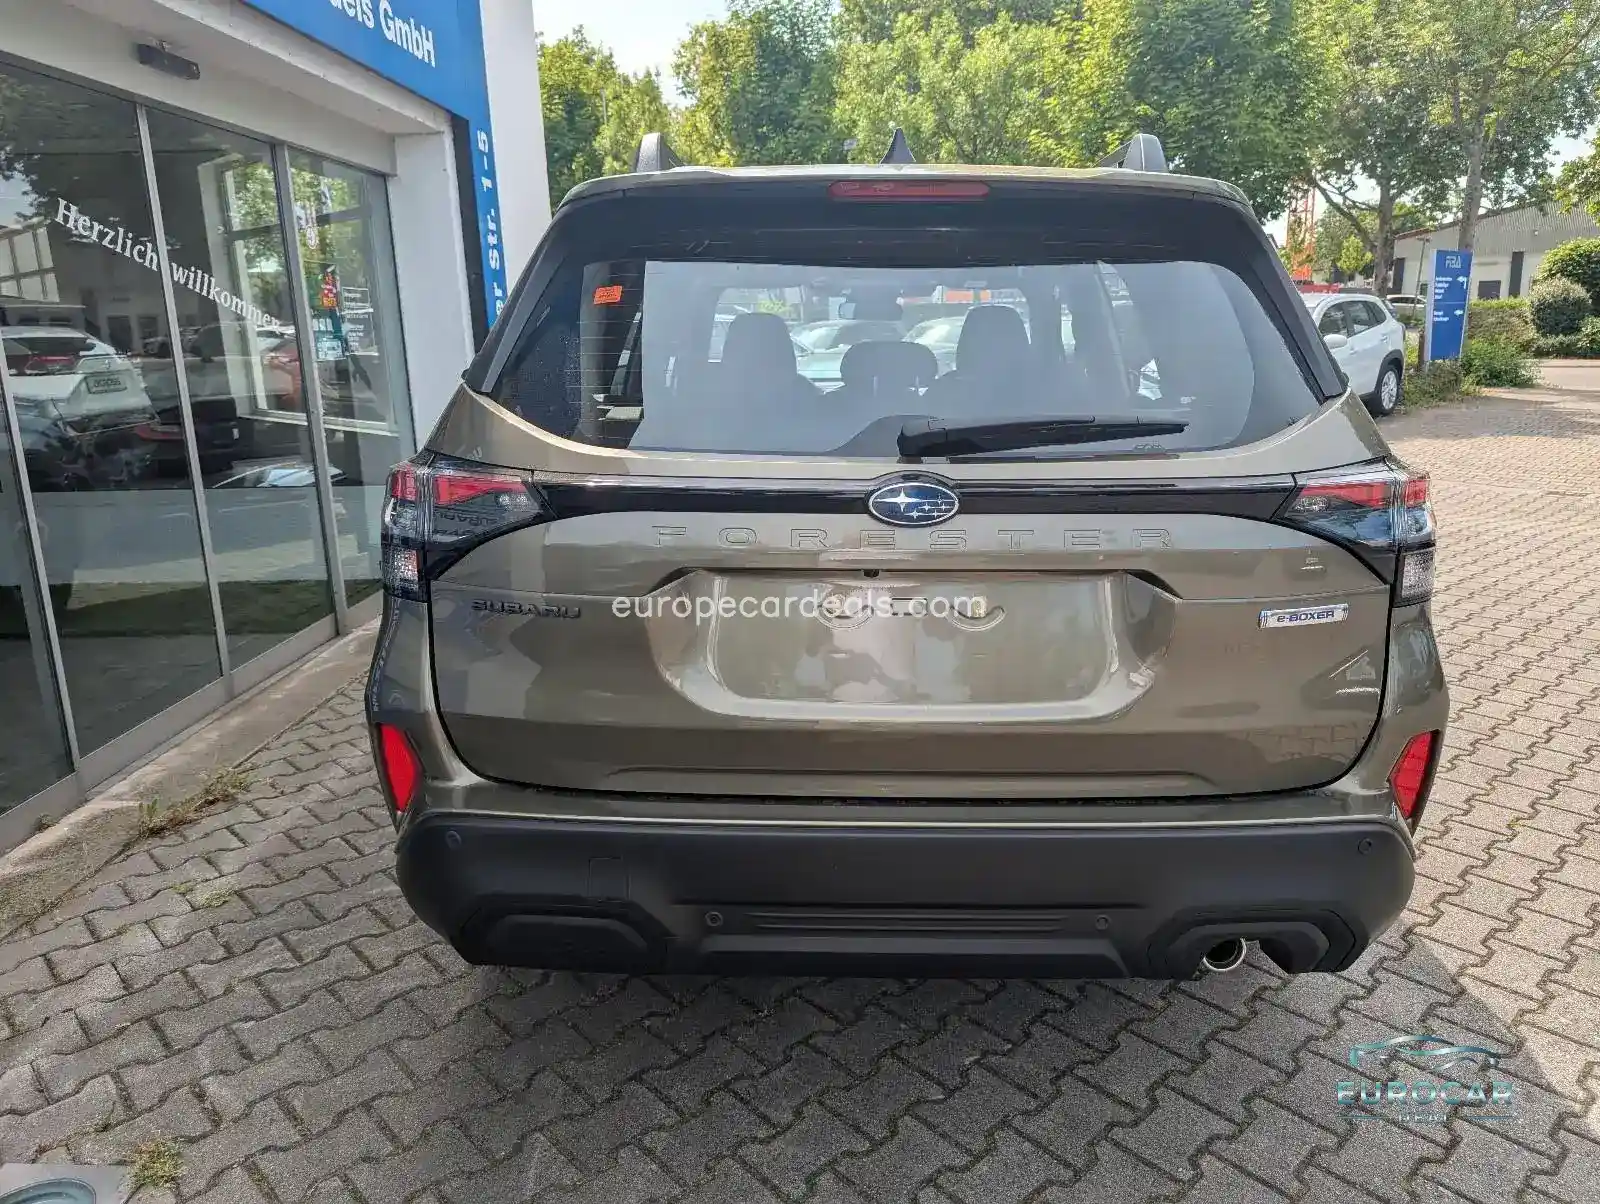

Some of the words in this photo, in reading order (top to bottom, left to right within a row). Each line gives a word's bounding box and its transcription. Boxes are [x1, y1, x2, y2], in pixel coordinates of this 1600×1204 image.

[379, 0, 436, 68] GmbH
[55, 197, 159, 271] Herzlich
[171, 262, 284, 334] willkommen
[652, 525, 1173, 551] FORESTER
[471, 600, 582, 619] SUBARU
[1276, 610, 1336, 623] e-BOXER
